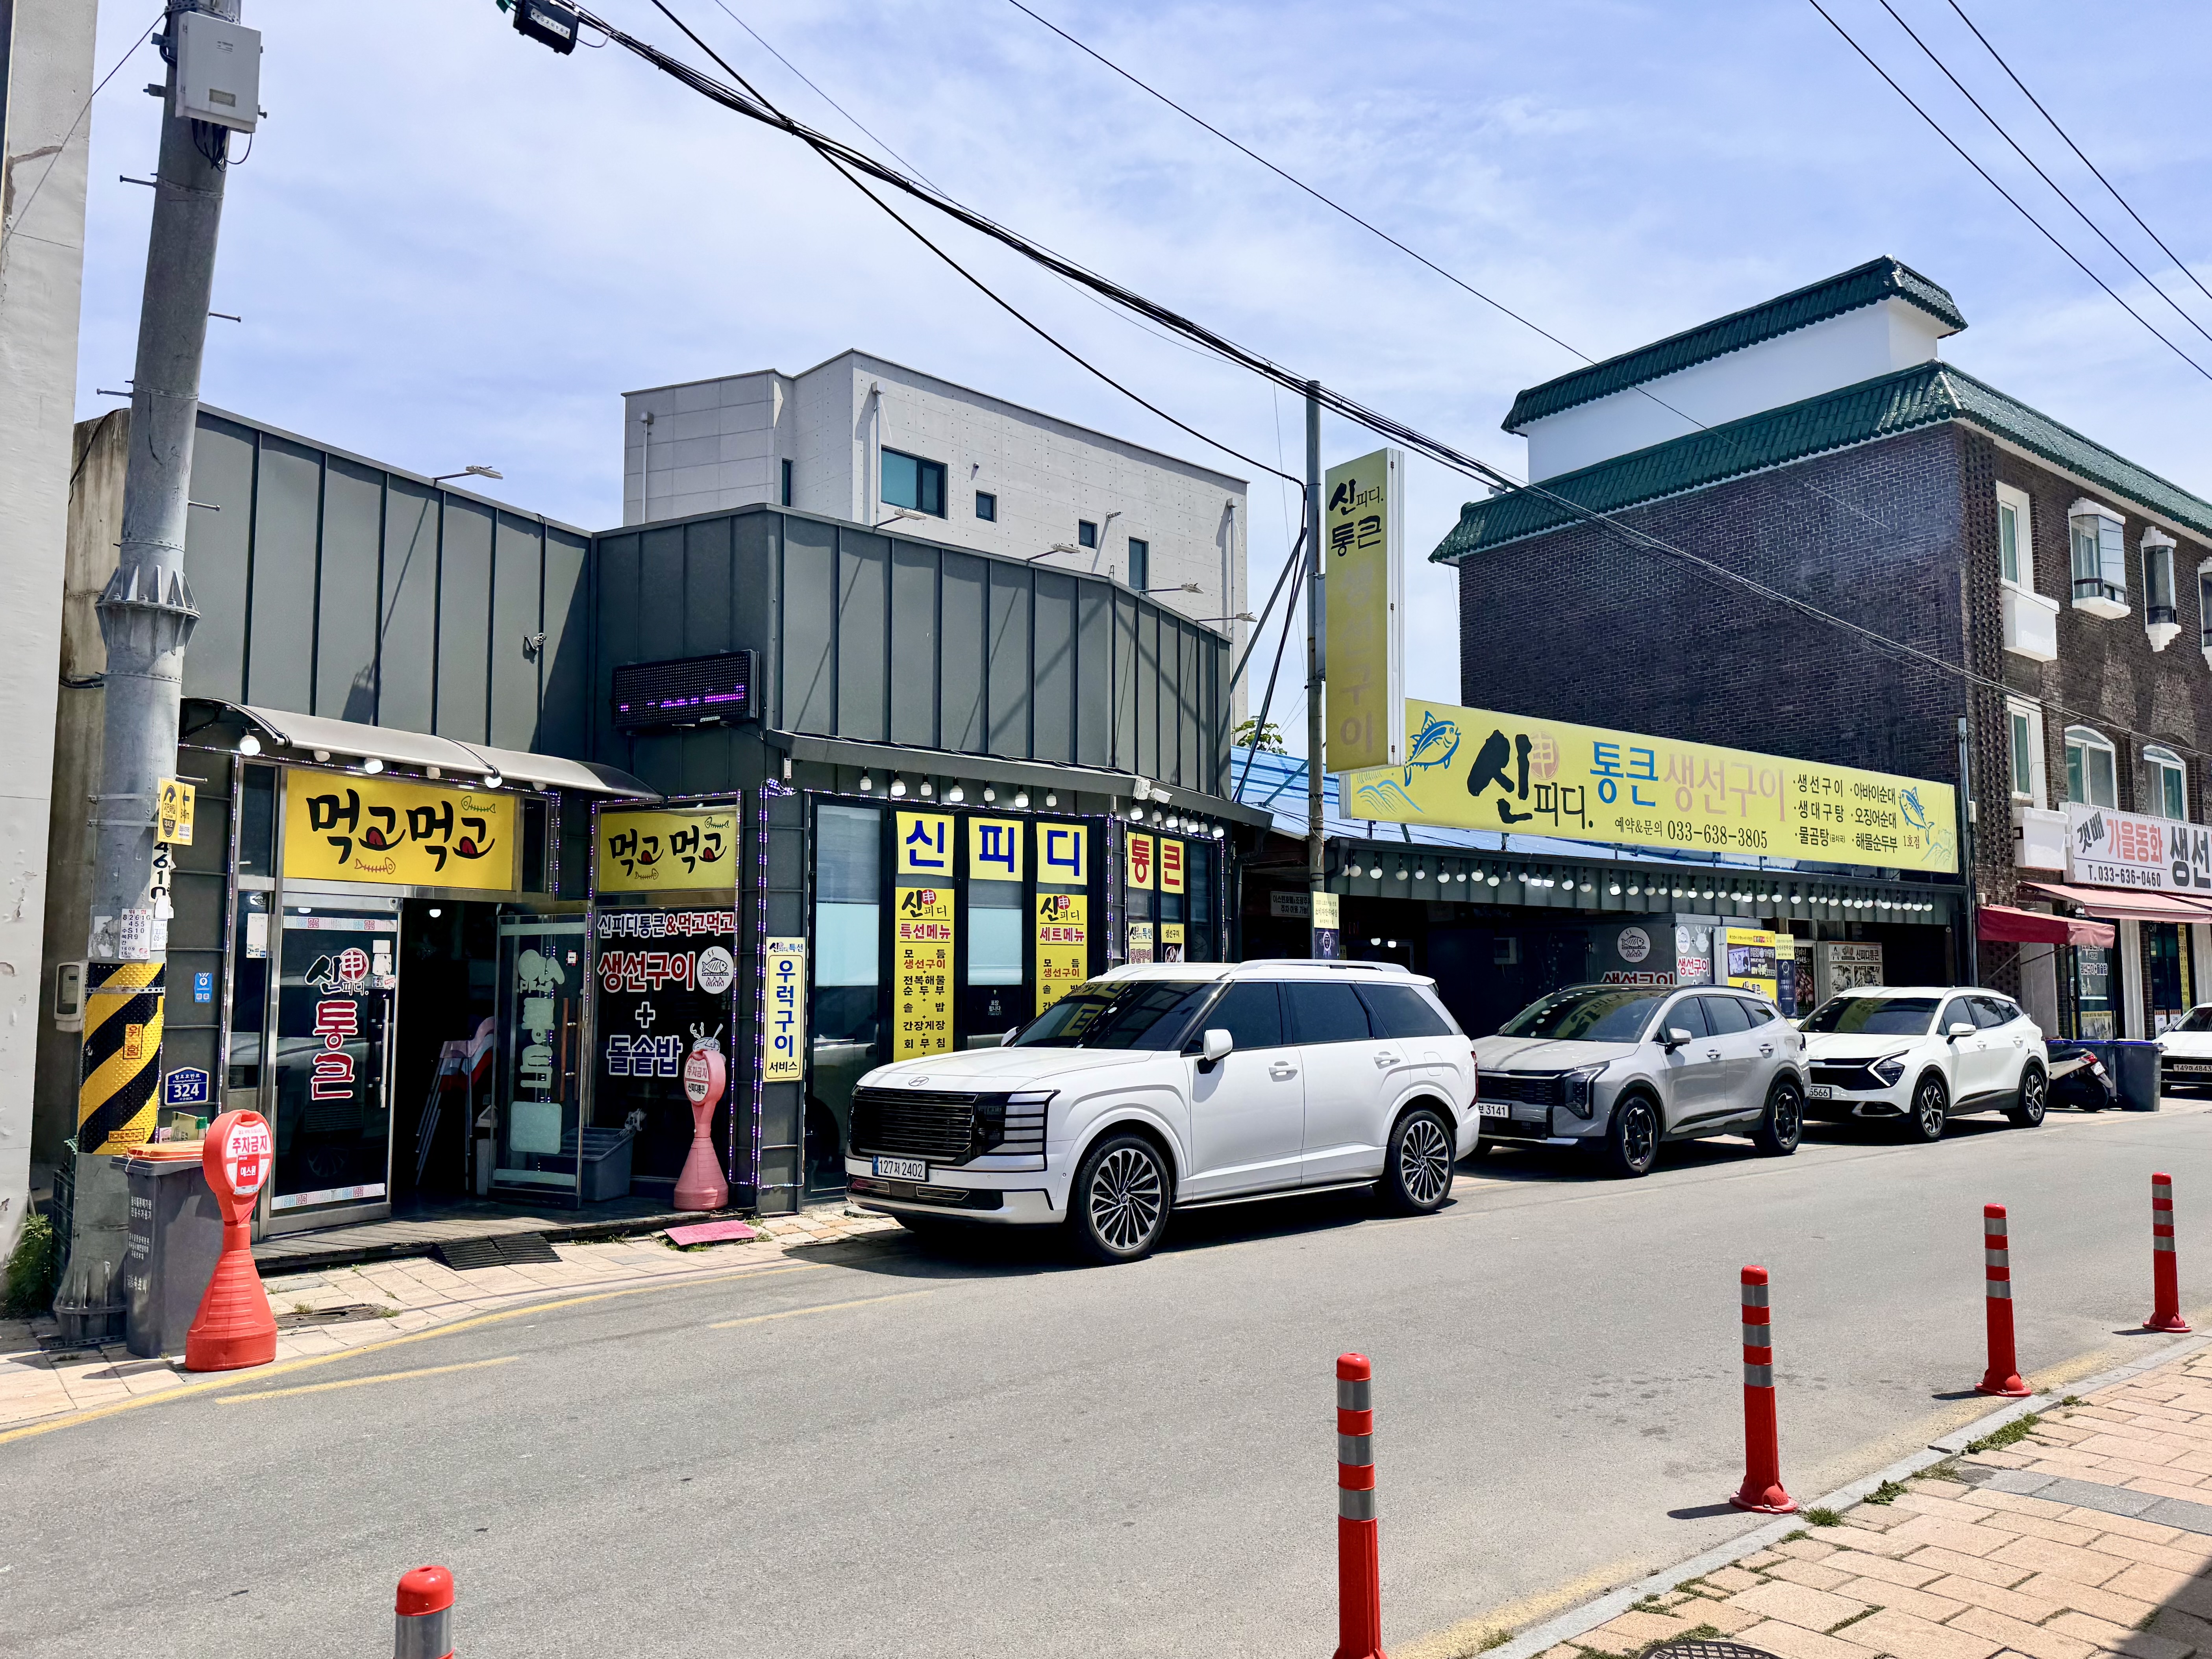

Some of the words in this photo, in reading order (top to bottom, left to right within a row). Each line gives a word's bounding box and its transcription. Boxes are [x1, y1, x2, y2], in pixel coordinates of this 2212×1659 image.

[1331, 515, 1382, 557] 통큰
[1590, 741, 1659, 807] 통큰
[1663, 753, 1786, 822] 생선구이
[1854, 782, 1895, 805] 아바이순대
[1798, 800, 1844, 823] 생대구탕
[1855, 807, 1897, 830] 오징어순대
[1614, 817, 1662, 837] 예약&문의
[1668, 820, 1768, 848] 033-638-3805
[2077, 811, 2105, 854] 갯배
[2106, 818, 2163, 864] 가을동화
[1855, 832, 1898, 854] 해물순두부
[1903, 835, 1920, 849] 1호점
[900, 923, 951, 940] 특선메뉴
[1040, 927, 1085, 942] 세트메뉴
[1142, 928, 1152, 939] 특선
[1165, 929, 1179, 938] 생선구이
[789, 943, 803, 952] 특선
[597, 951, 695, 993] 생선구이
[904, 959, 945, 969] 생선구이
[1043, 968, 1079, 977] 생선구이
[1677, 957, 1710, 977] 생선구이
[903, 976, 946, 985] 전복해물
[775, 960, 796, 1057] 우럭구이
[903, 1020, 945, 1031] 간장게장
[311, 1000, 358, 1101] 통큰
[606, 1034, 683, 1078] 돌솥밥
[769, 1061, 798, 1073] 서비스
[174, 1083, 200, 1098] 324
[232, 1135, 267, 1154] 주차금지
